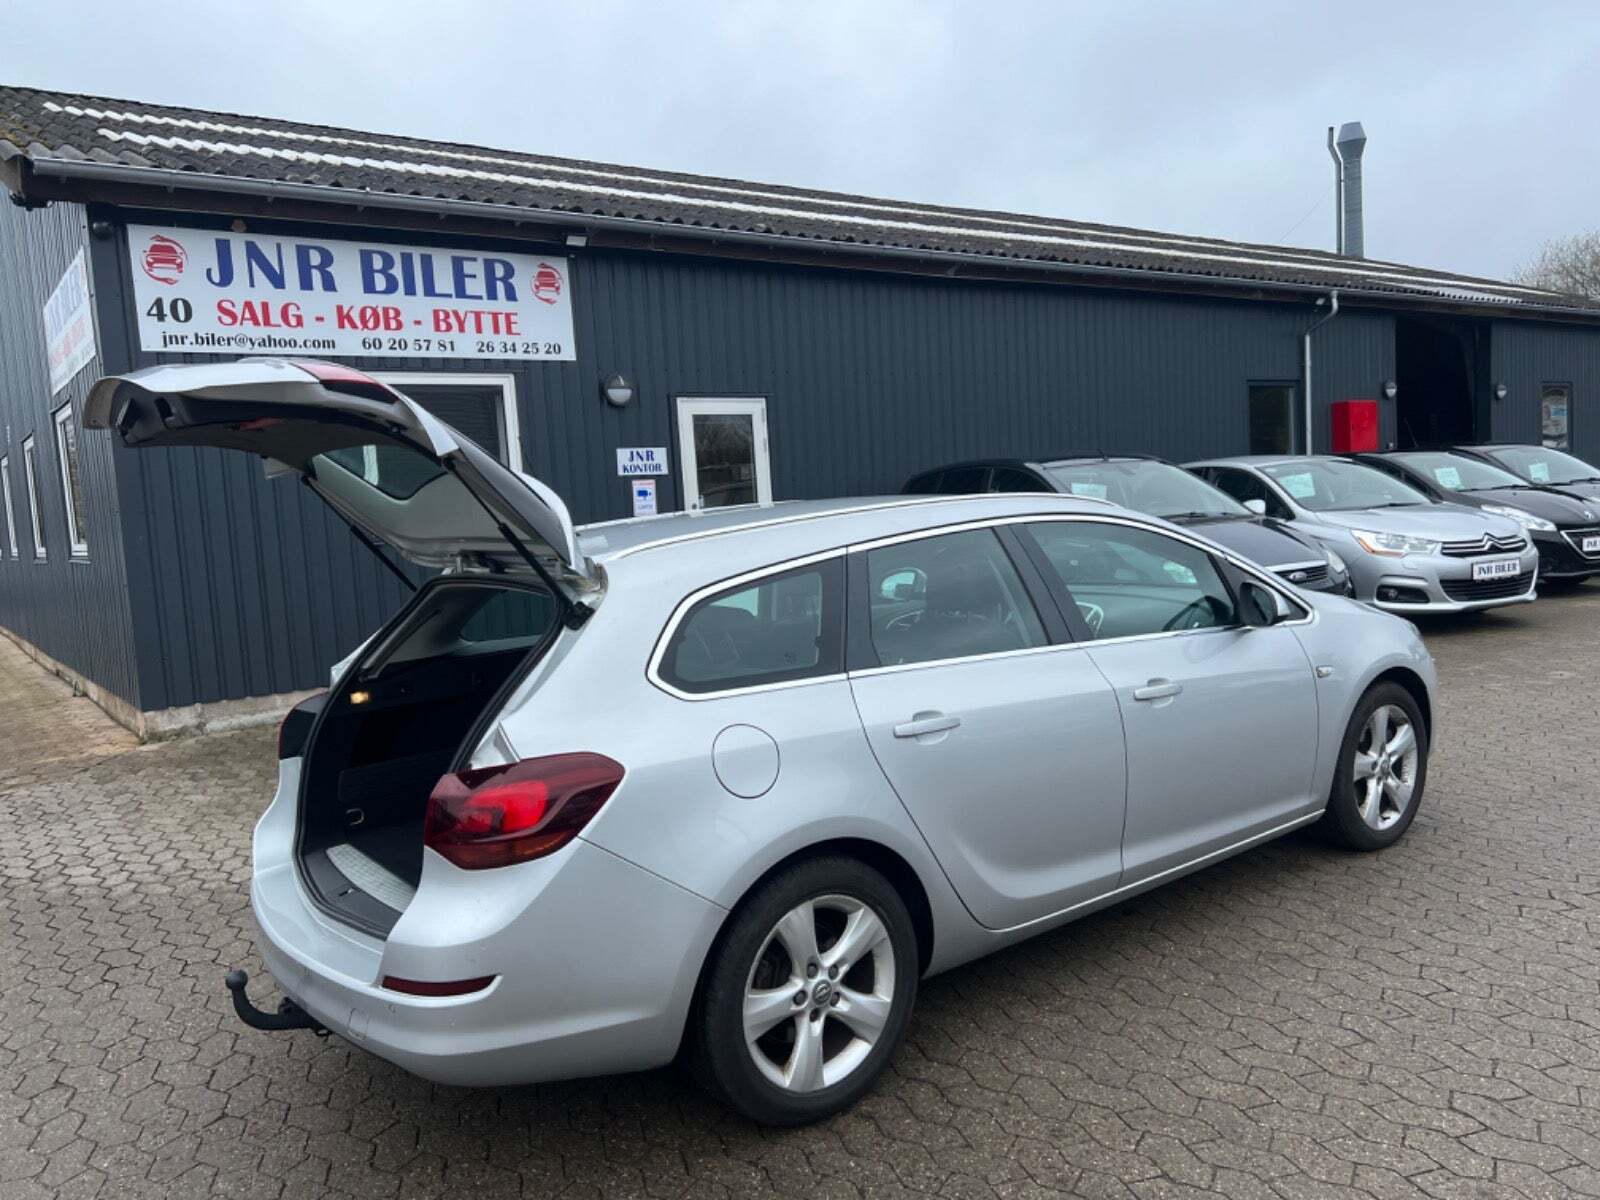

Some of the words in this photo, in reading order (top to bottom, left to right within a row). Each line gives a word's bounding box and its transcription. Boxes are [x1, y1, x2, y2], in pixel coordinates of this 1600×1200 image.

[206, 238, 338, 292] JNR
[359, 249, 518, 302] BILER
[146, 297, 193, 323] 40
[216, 299, 304, 329] SALG
[336, 304, 404, 331] KØB
[432, 309, 521, 336] BYTTE
[162, 331, 336, 350] jnr.biler@yahoo.com
[362, 337, 382, 351] 60
[388, 338, 408, 351] 20
[413, 339, 432, 352] 57
[437, 340, 455, 352] 81
[476, 340, 494, 354] 26
[500, 342, 517, 354] 34
[522, 343, 539, 355] 25
[544, 343, 561, 355] 20
[629, 450, 655, 462] JNR
[623, 463, 662, 473] KONTOR
